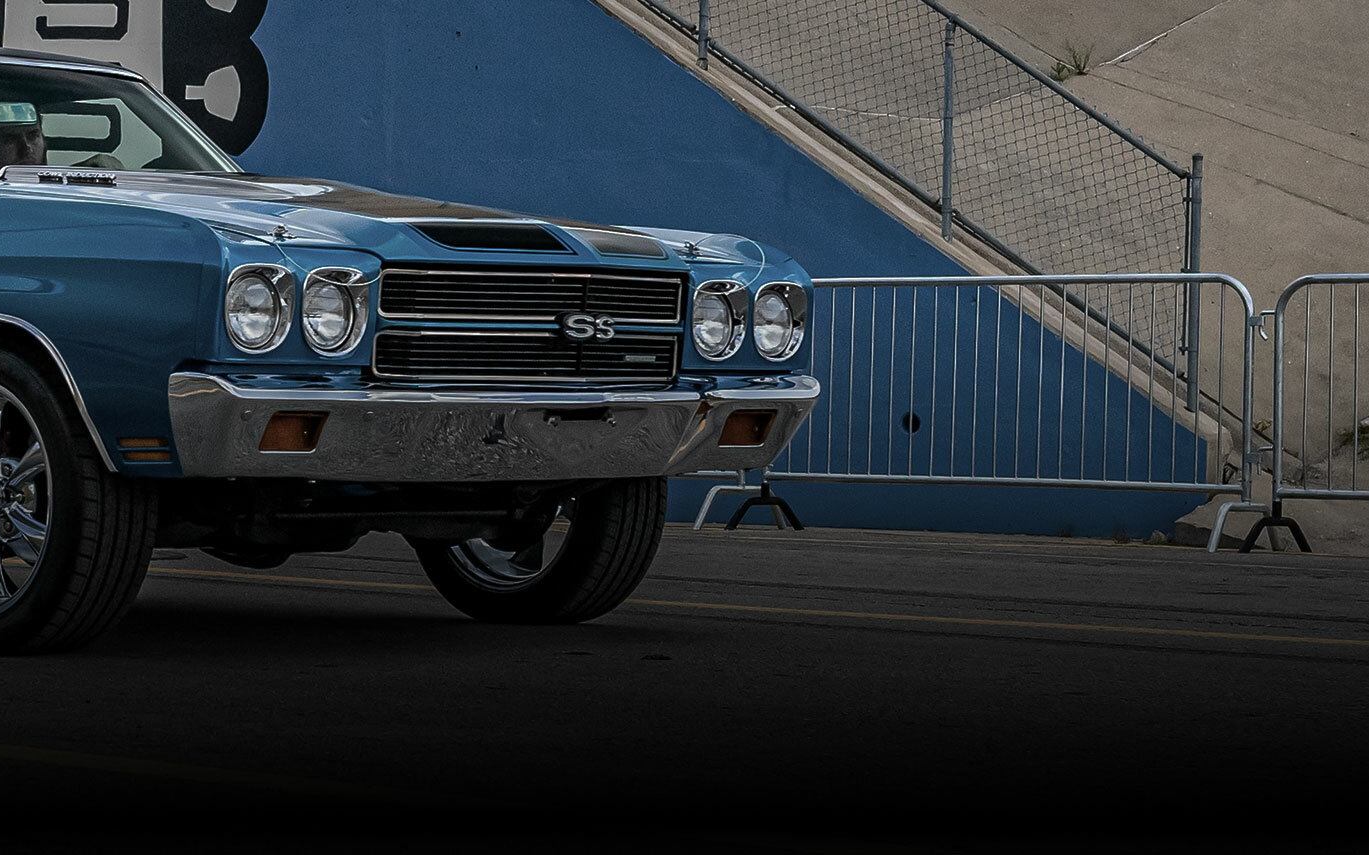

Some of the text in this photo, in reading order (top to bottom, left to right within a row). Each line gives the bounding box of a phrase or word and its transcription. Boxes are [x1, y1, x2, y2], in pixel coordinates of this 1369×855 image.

[37, 170, 116, 182] COWL INDUCTION
[565, 314, 615, 340] SS
